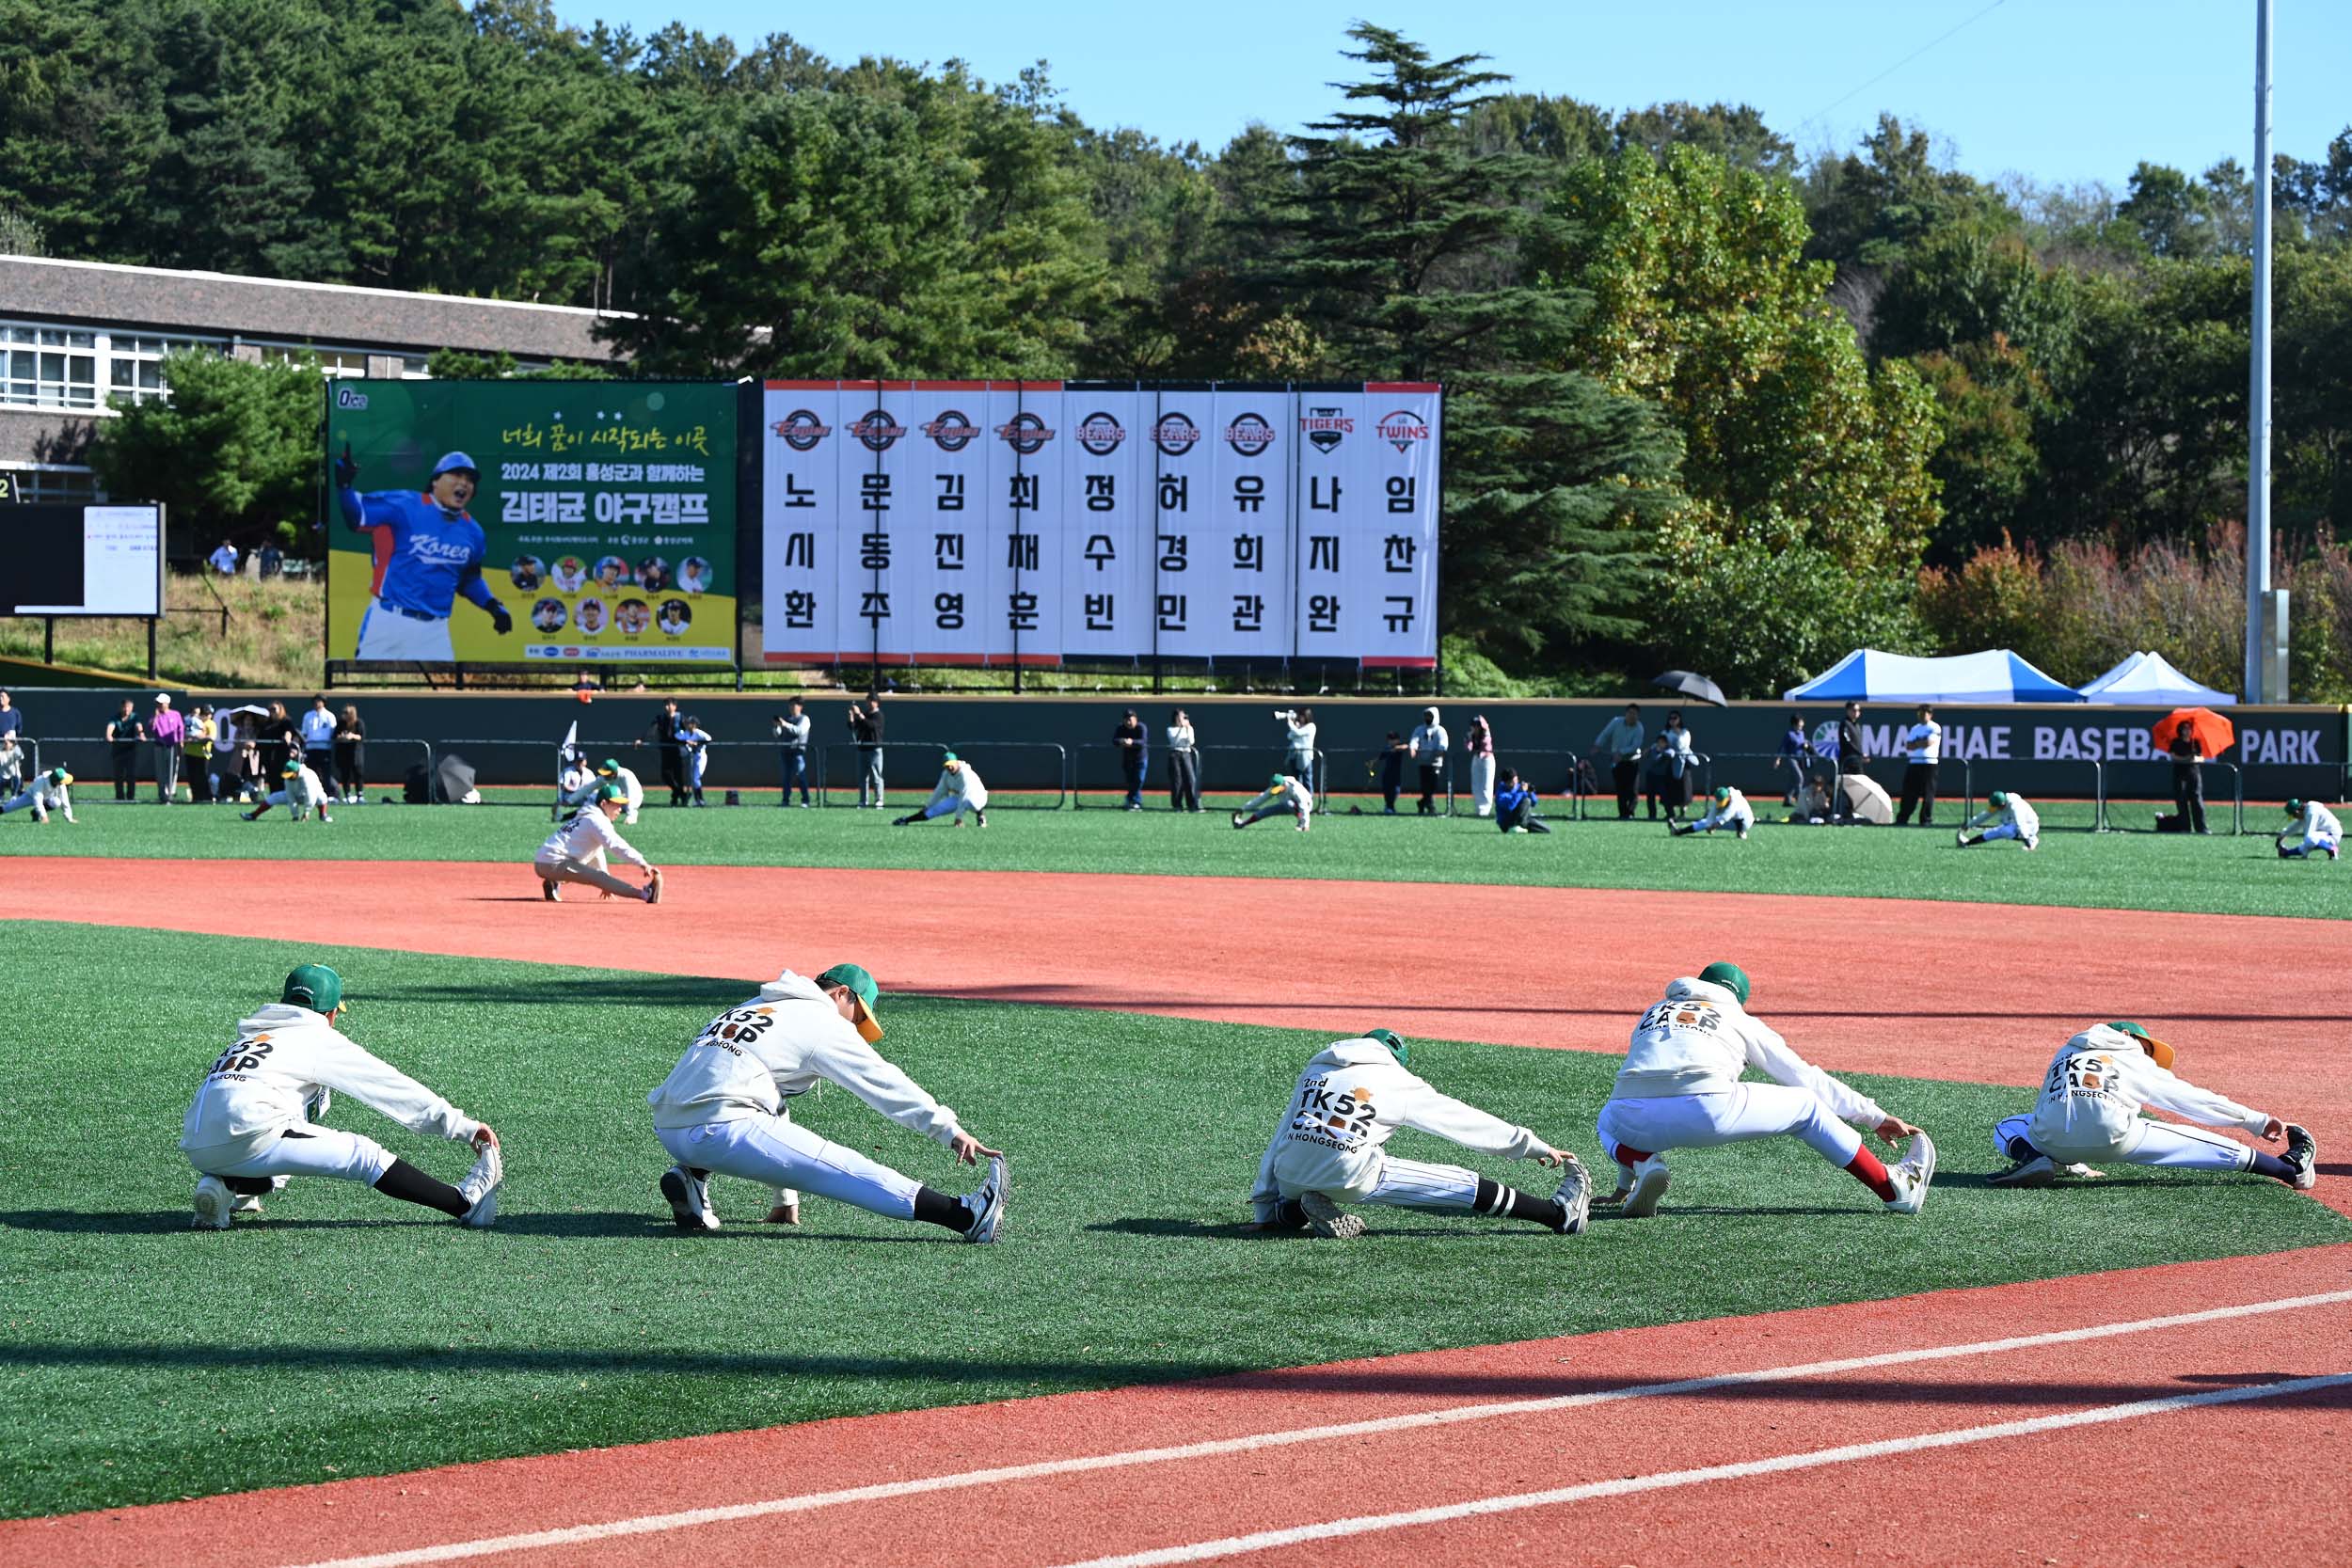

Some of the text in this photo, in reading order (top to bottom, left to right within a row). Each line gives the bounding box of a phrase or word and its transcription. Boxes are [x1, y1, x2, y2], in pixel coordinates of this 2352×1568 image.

[501, 422, 709, 456] 너희 꿈이 시작되는 이곳
[1074, 424, 1126, 441] BEARS
[1150, 425, 1200, 441] BEARS
[1225, 425, 1276, 442] BEARS
[1299, 419, 1354, 433] TIGERS
[1375, 425, 1429, 439] TWINS
[501, 463, 705, 483] 2024 제2회 홍성군과 함께하는
[501, 491, 709, 525] 김태균 야구캠프
[408, 534, 470, 561] Korea
[785, 473, 816, 628] 노시환
[860, 473, 892, 630] 문동주
[934, 473, 964, 630] 김진영
[1008, 472, 1040, 631] 최재훈
[1085, 474, 1116, 631] 정수빈
[1157, 473, 1187, 631] 허경민
[1232, 474, 1264, 631] 유희관
[1309, 474, 1343, 633] 나지완
[1383, 475, 1417, 633] 임찬규
[1861, 724, 2011, 760] MAHAE
[2241, 729, 2321, 764] PARK
[1302, 1078, 1328, 1087] 2nd
[1301, 1089, 1376, 1127] TK52
[1295, 1133, 1358, 1153] HONGSEONG
